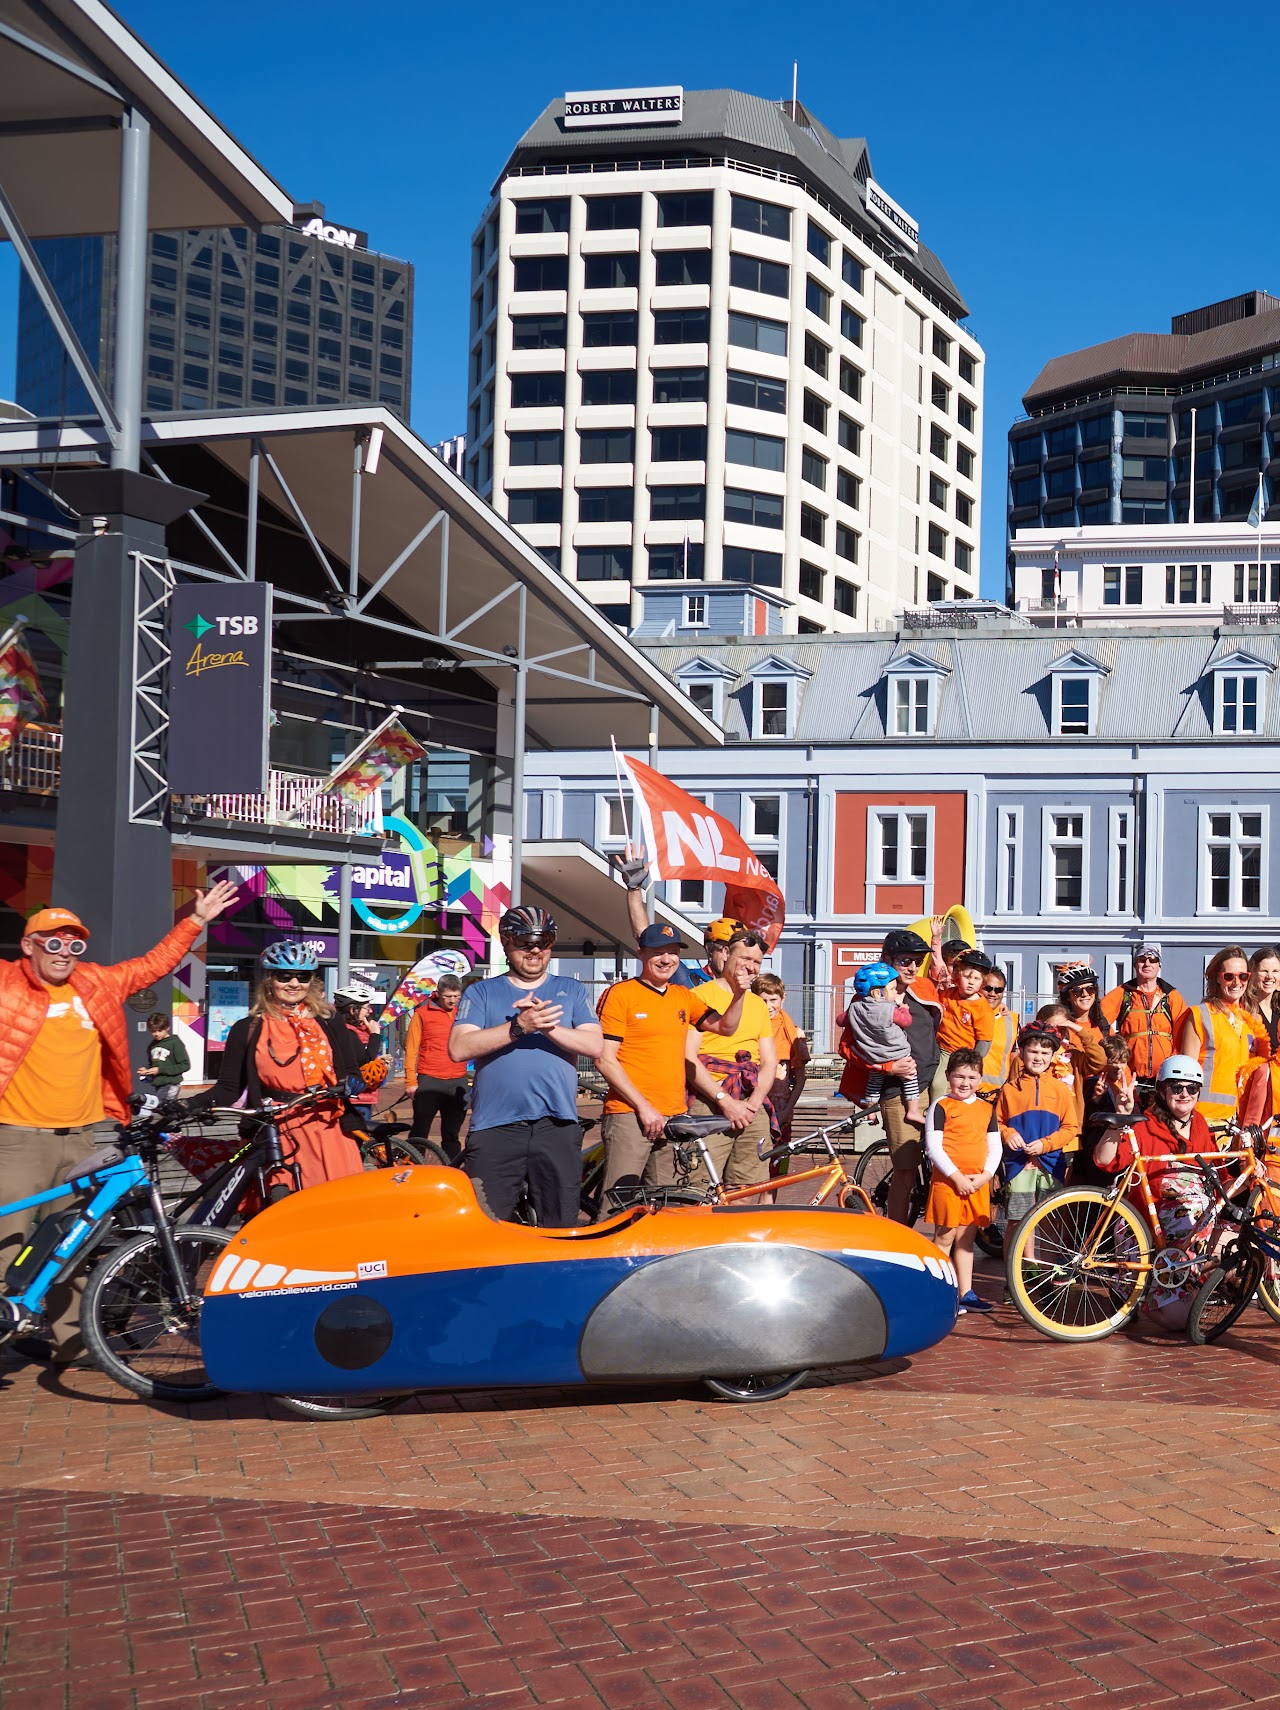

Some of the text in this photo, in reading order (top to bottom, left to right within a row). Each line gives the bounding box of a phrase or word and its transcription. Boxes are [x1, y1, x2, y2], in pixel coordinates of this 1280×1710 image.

[565, 97, 681, 115] ROBERT WALTERS
[301, 218, 358, 250] AON
[893, 212, 919, 243] WALTERS
[215, 615, 259, 636] TSB
[185, 642, 247, 677] Arena
[661, 810, 741, 873] NL
[202, 1164, 246, 1226] rratec
[364, 1262, 386, 1273] UCI
[238, 1282, 358, 1299] velomobileworld.com
